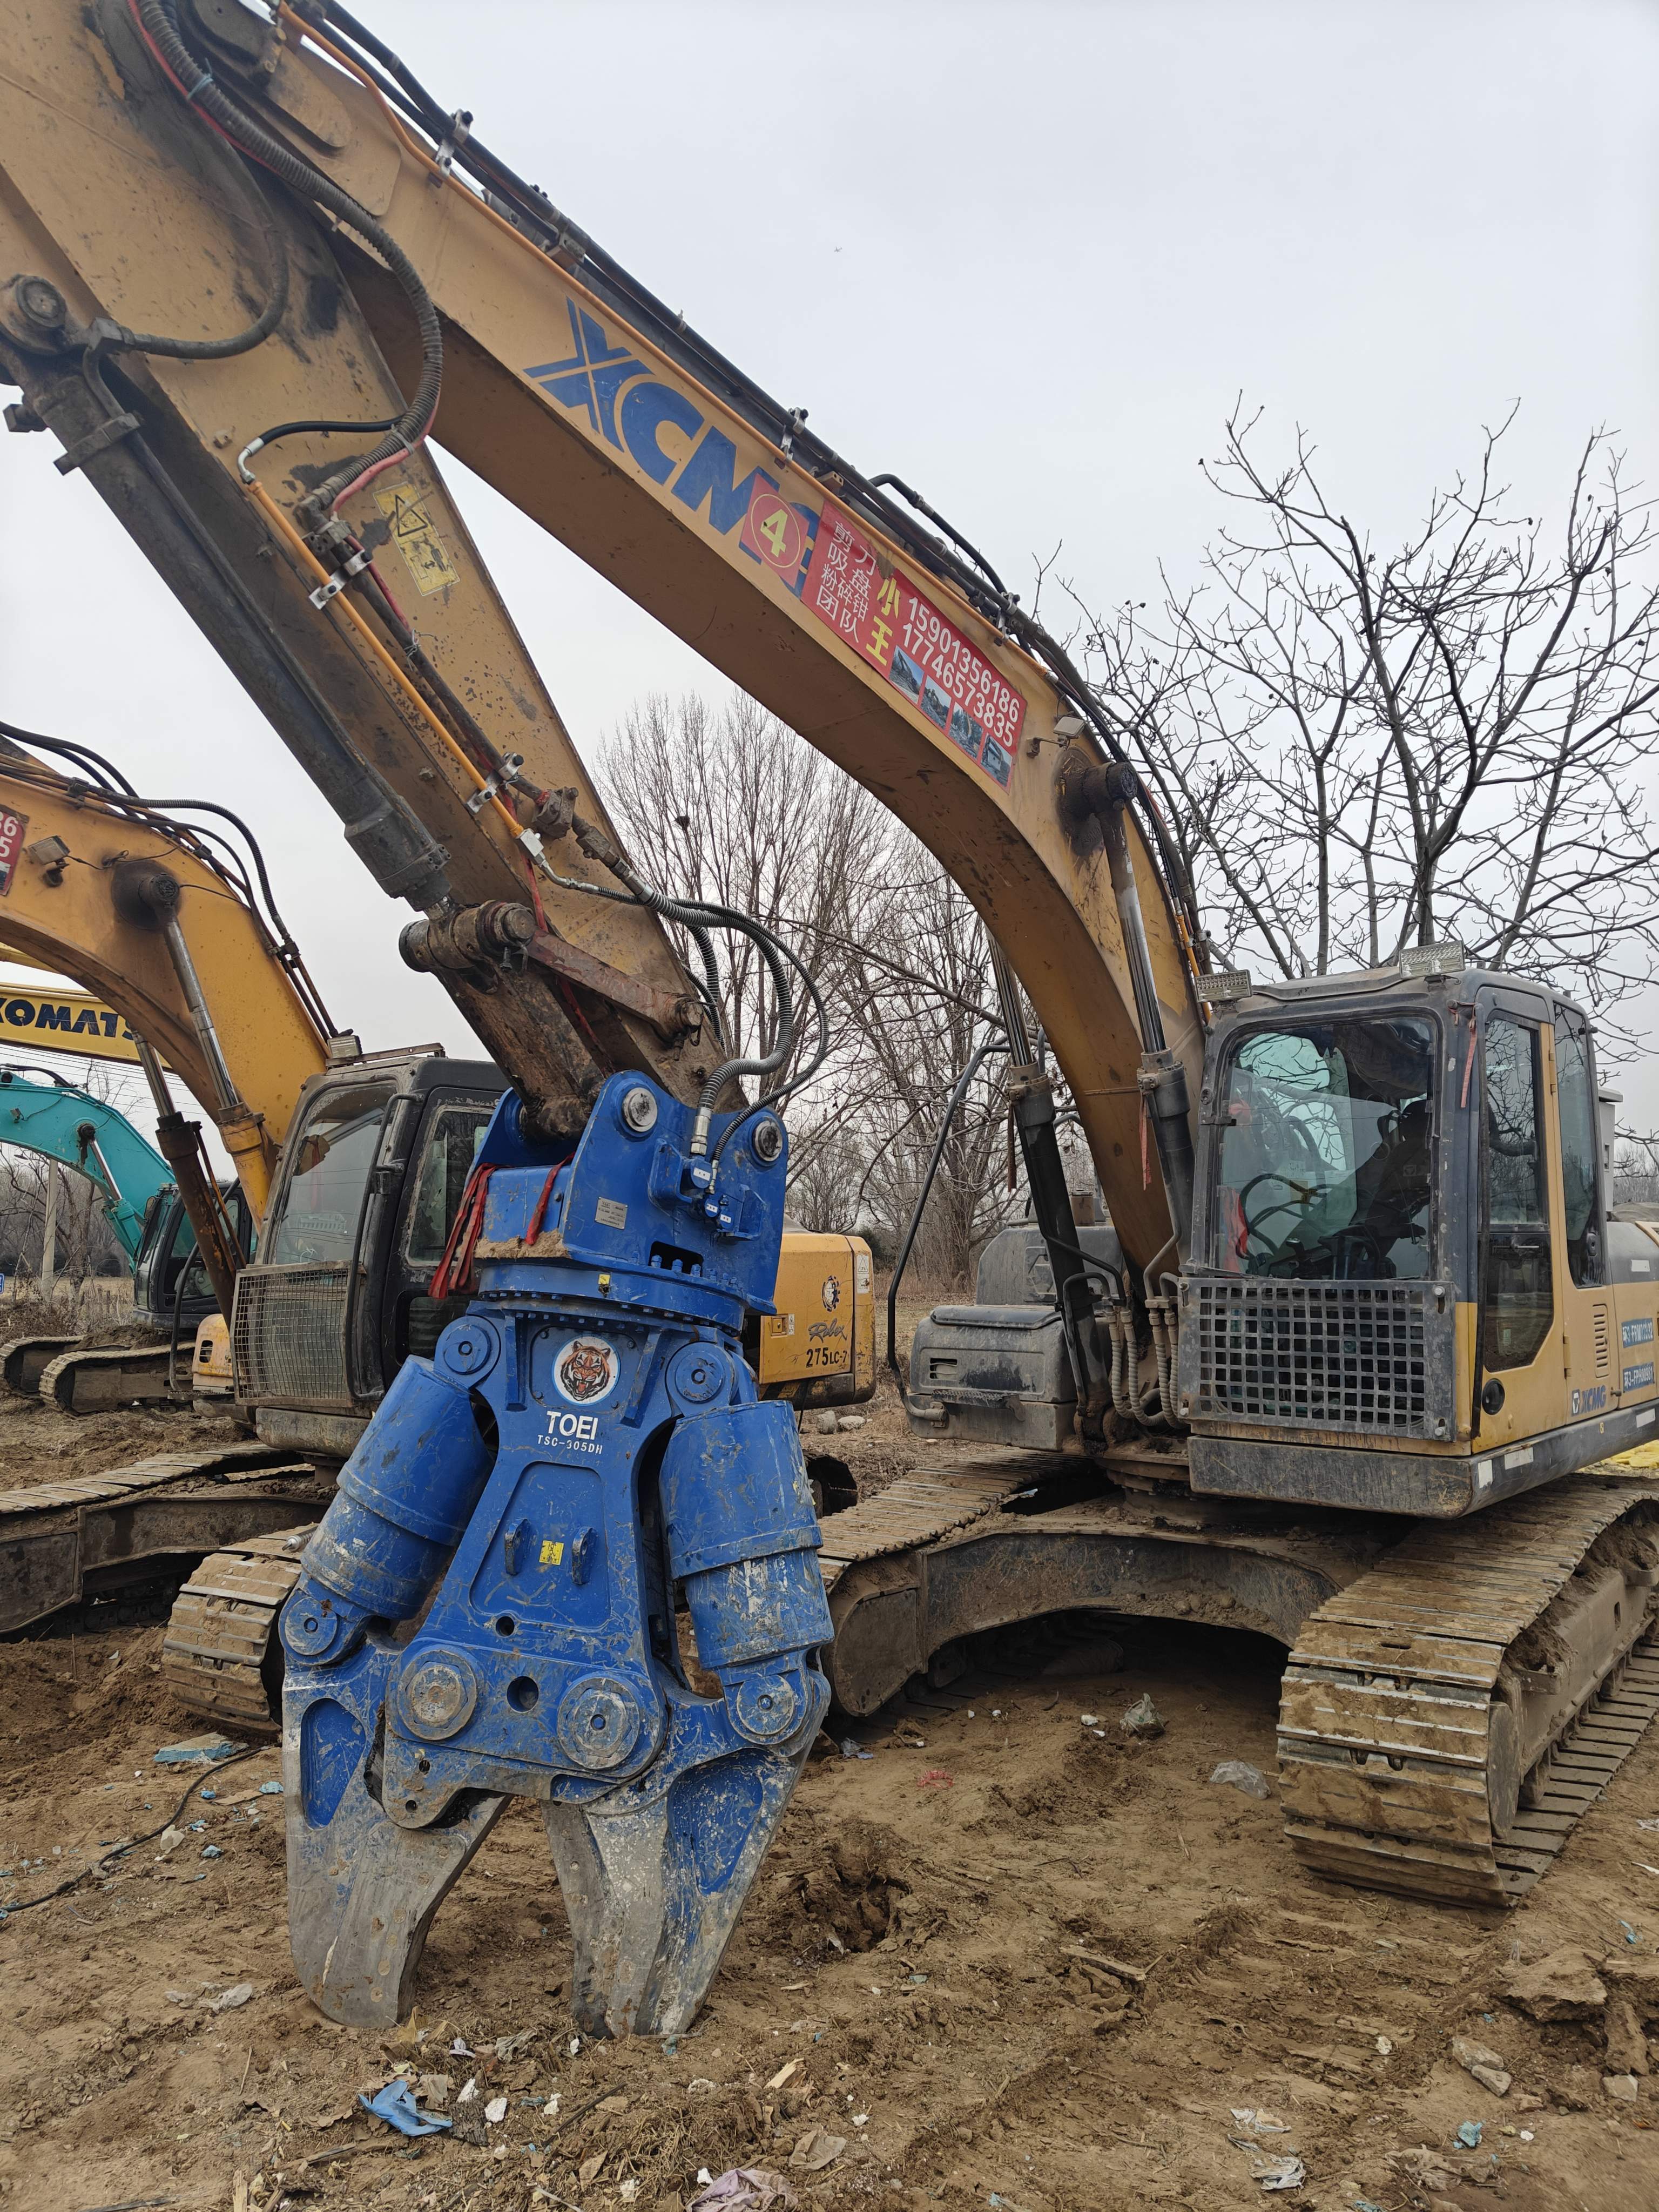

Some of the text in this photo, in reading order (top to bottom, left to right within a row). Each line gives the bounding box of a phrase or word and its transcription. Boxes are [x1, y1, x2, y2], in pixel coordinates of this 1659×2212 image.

[760, 509, 788, 558] 4
[833, 521, 876, 576] 剪刀
[821, 563, 868, 622] 粉碎钳
[828, 542, 872, 601] 吸盘
[817, 585, 859, 643] 团队
[903, 623, 1015, 747] 17746573835
[909, 597, 1020, 723] 15901356186
[0, 999, 134, 1040] OMAT
[547, 1411, 598, 1440] TOEI
[1581, 1385, 1606, 1413] XCMG
[537, 1435, 603, 1454] TSC-305DH
